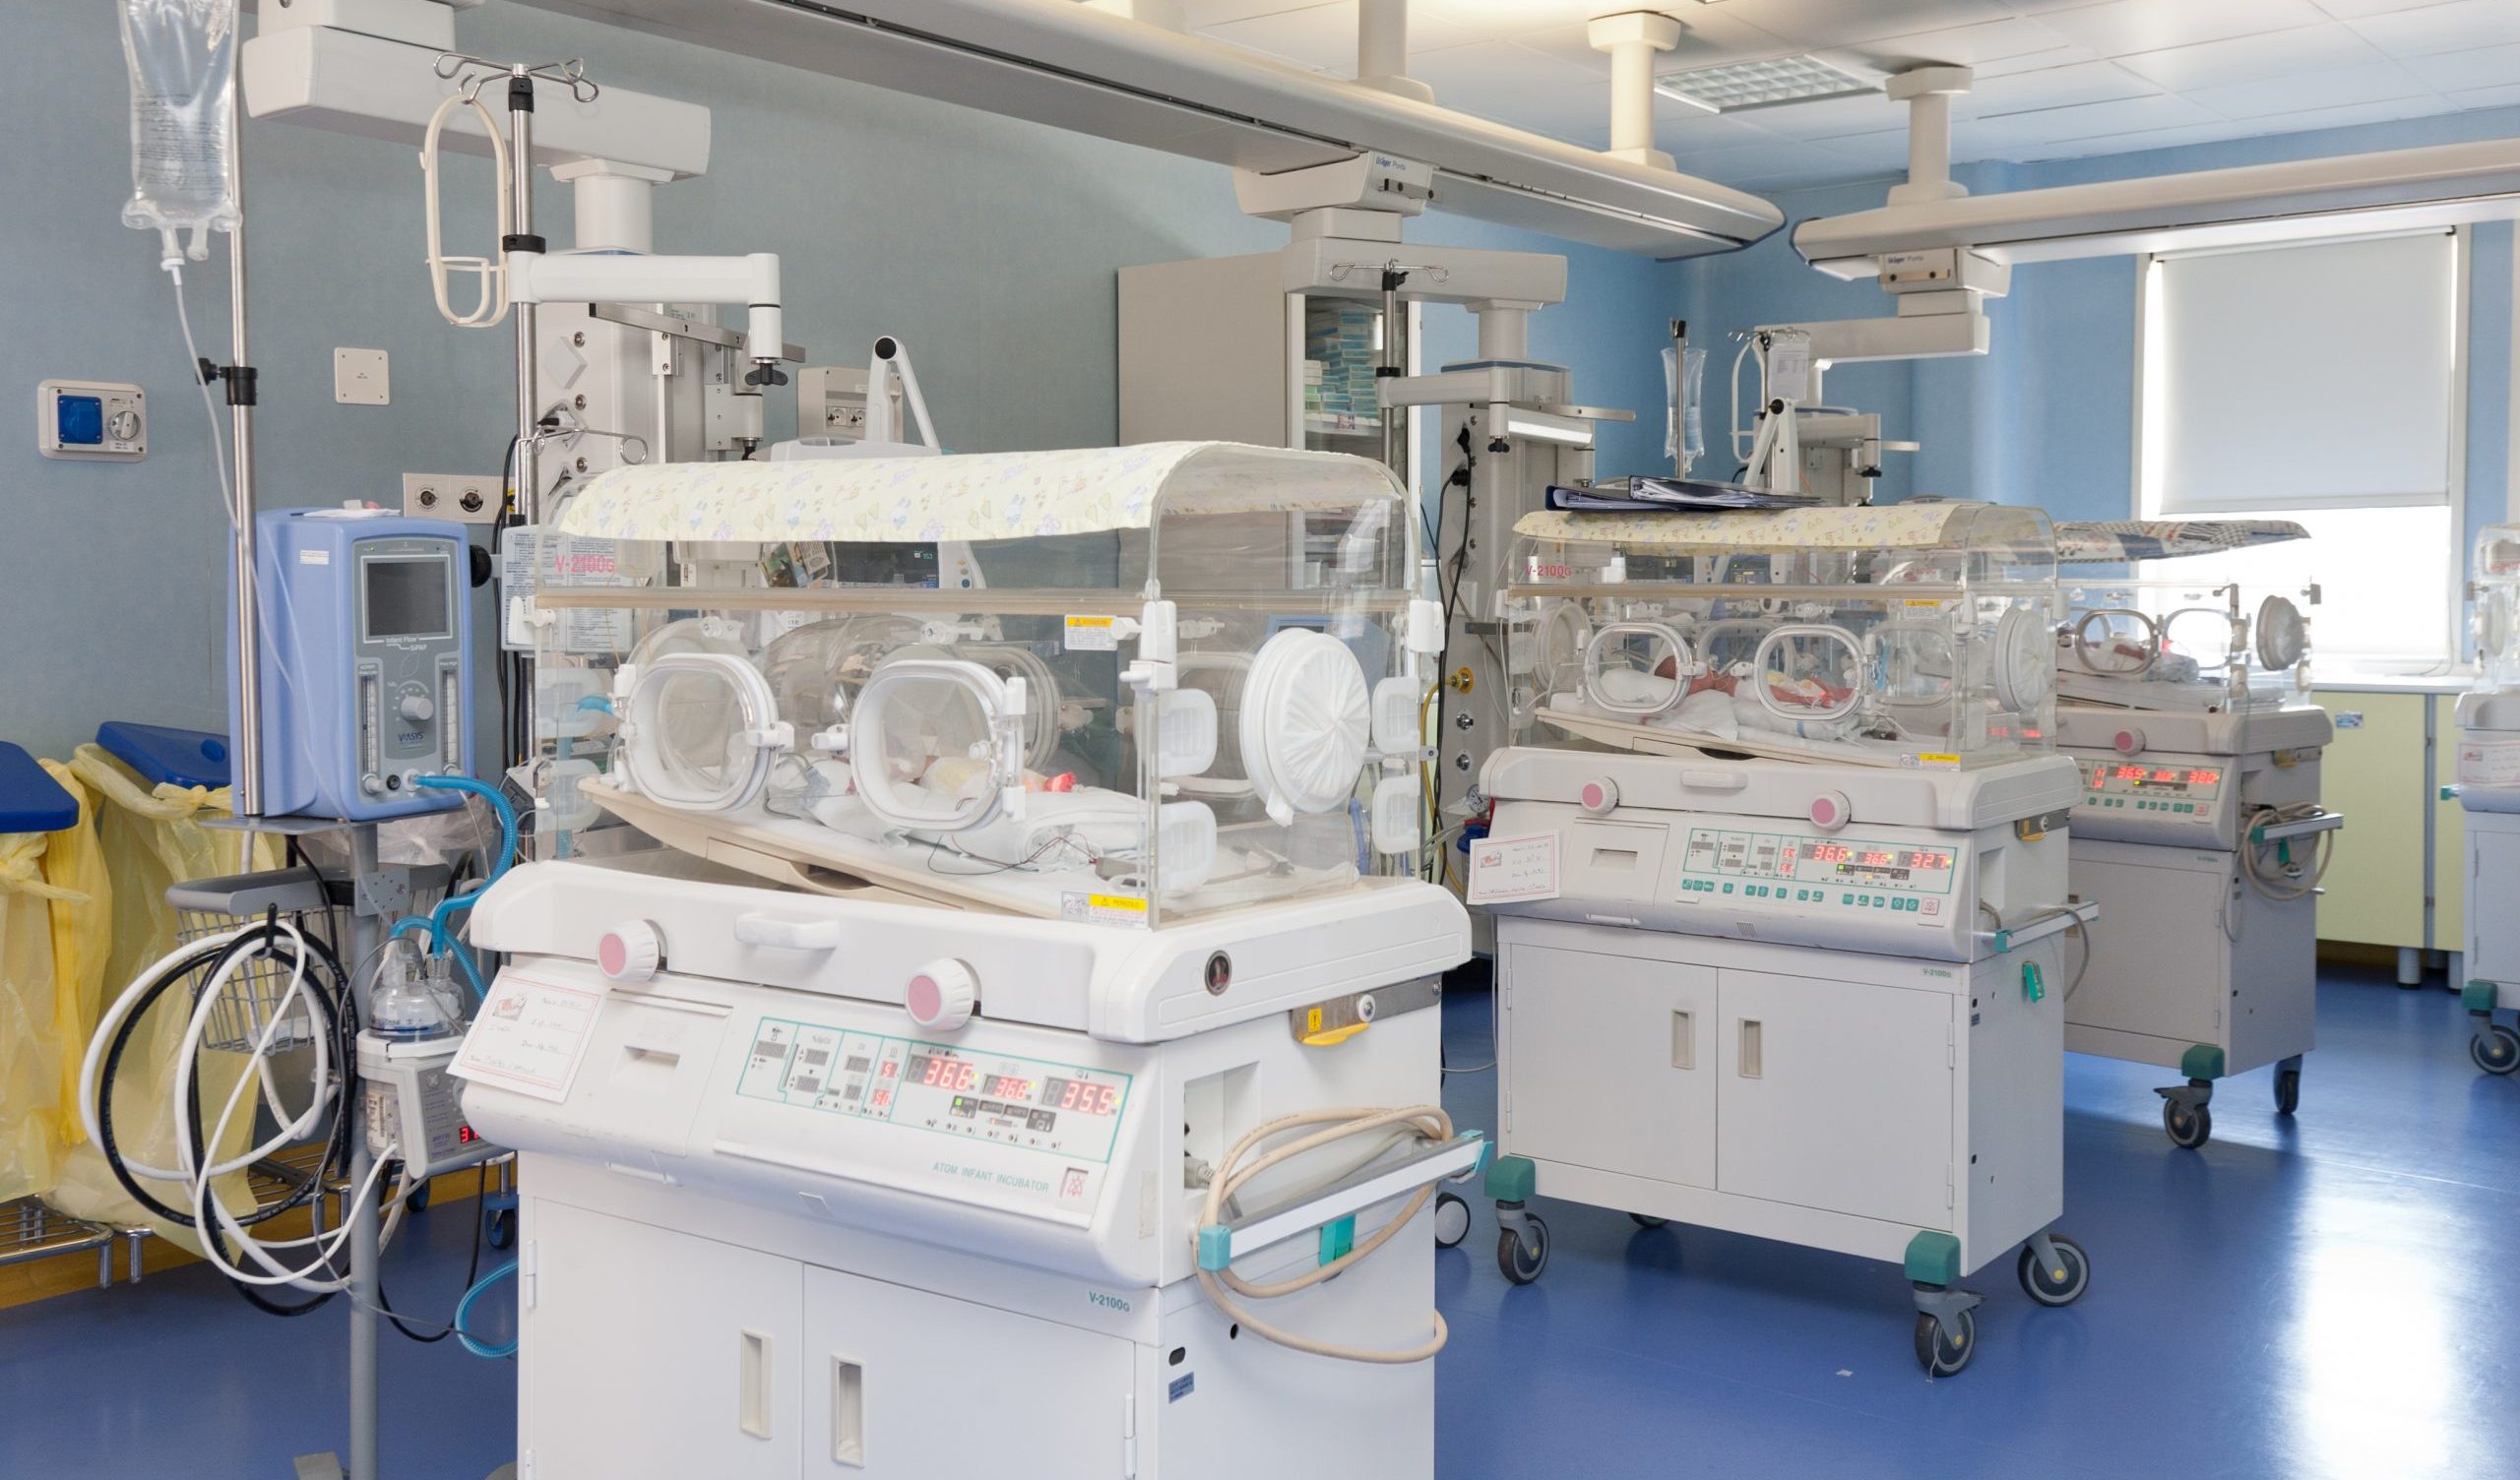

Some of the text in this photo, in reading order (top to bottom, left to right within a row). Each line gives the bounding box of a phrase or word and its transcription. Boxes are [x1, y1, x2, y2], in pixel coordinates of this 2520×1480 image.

[933, 1162, 1048, 1193] ATOM INFANT INCUBATOR
[1089, 1291, 1131, 1313] V-2100G
